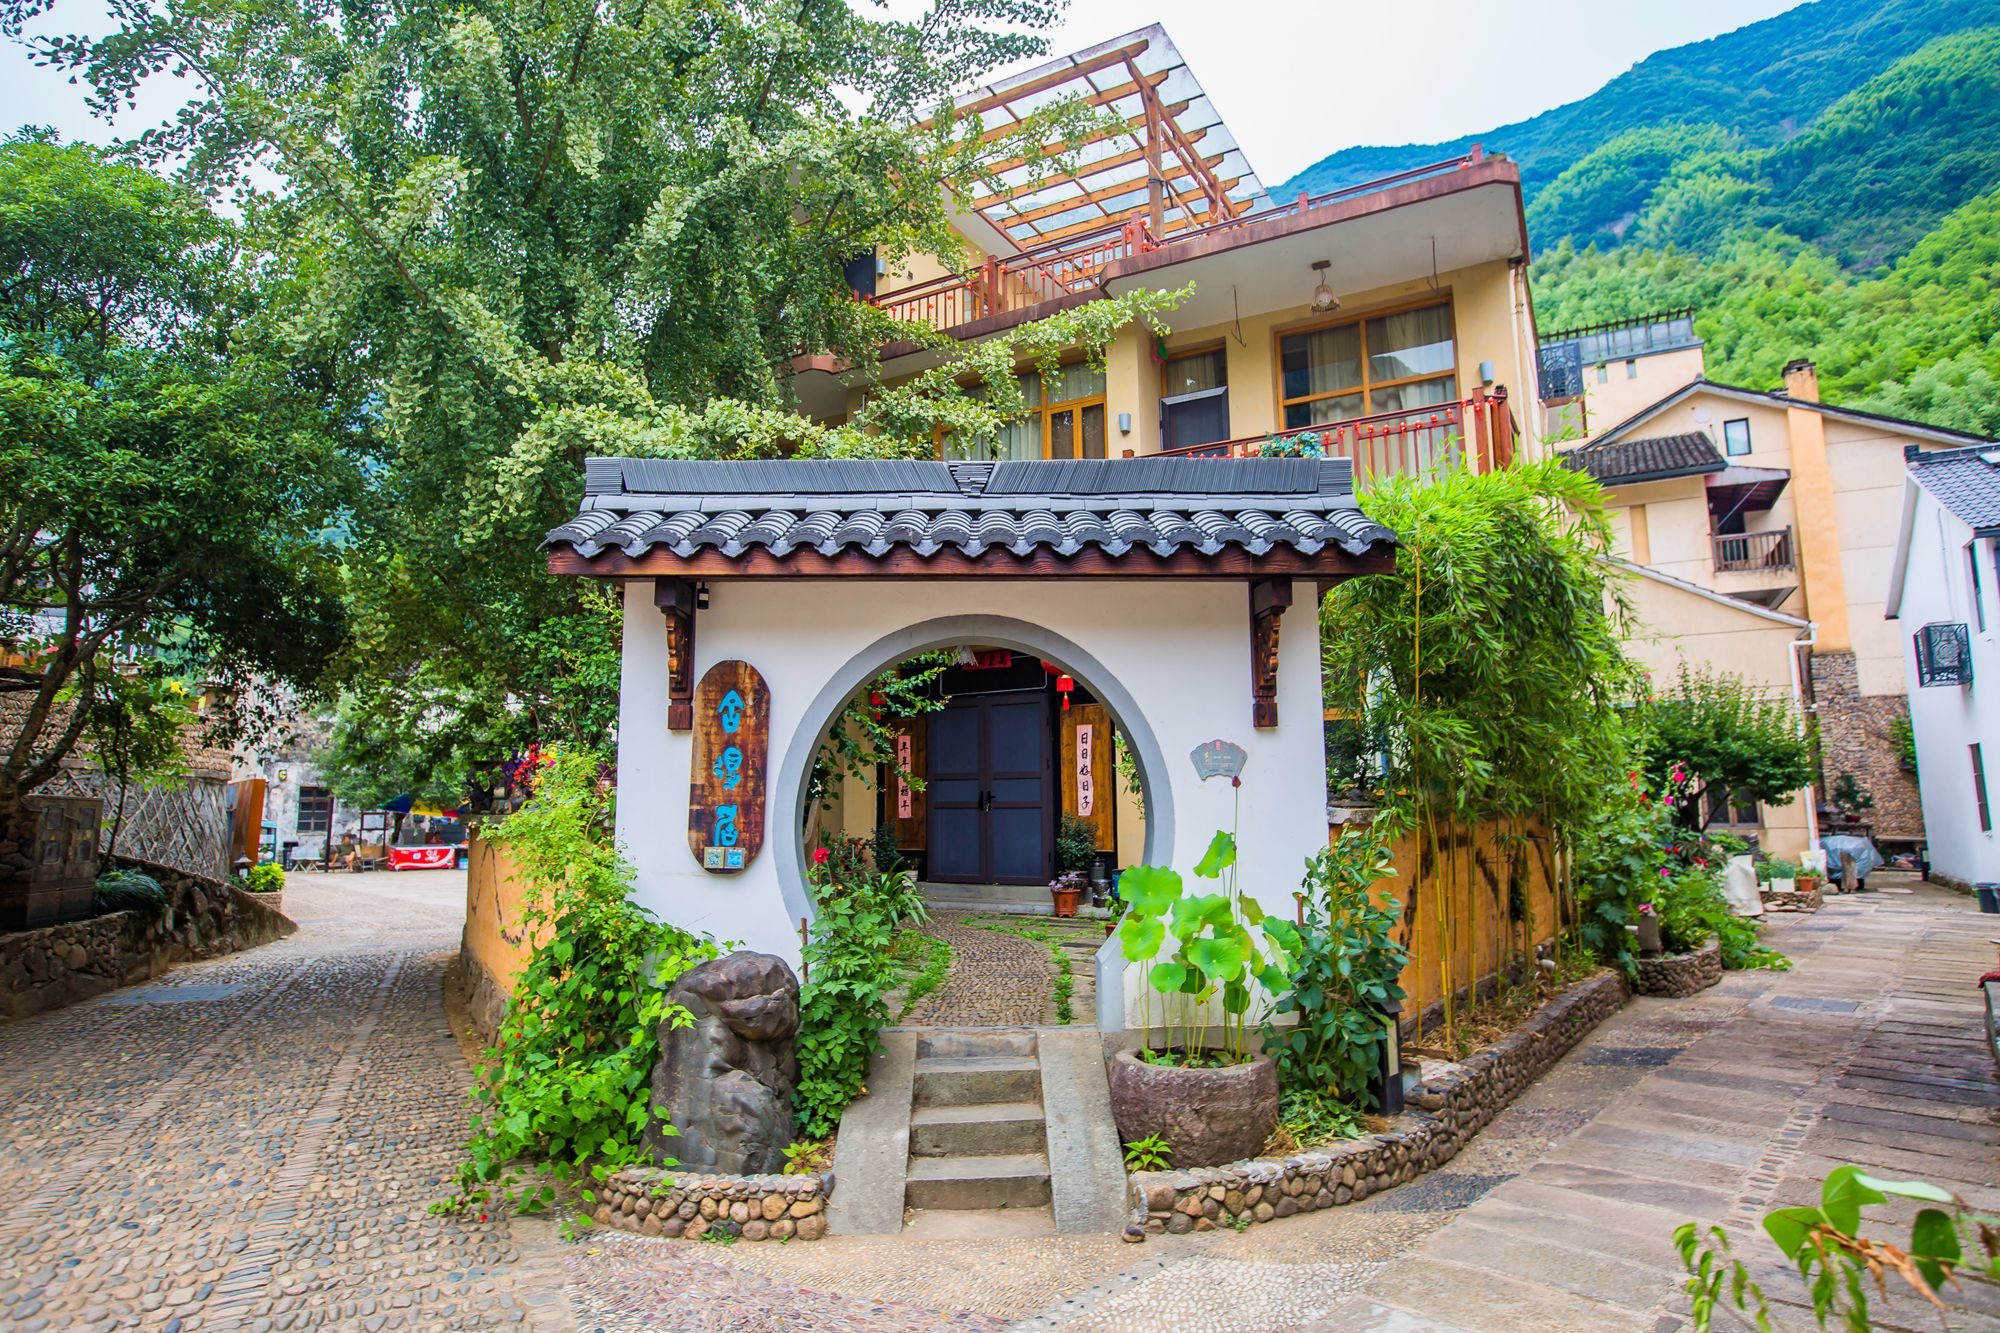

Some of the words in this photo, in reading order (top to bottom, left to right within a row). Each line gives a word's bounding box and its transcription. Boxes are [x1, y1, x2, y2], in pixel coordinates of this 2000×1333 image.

[900, 741, 909, 811] 年年福年
[1079, 732, 1090, 809] 日日好日子
